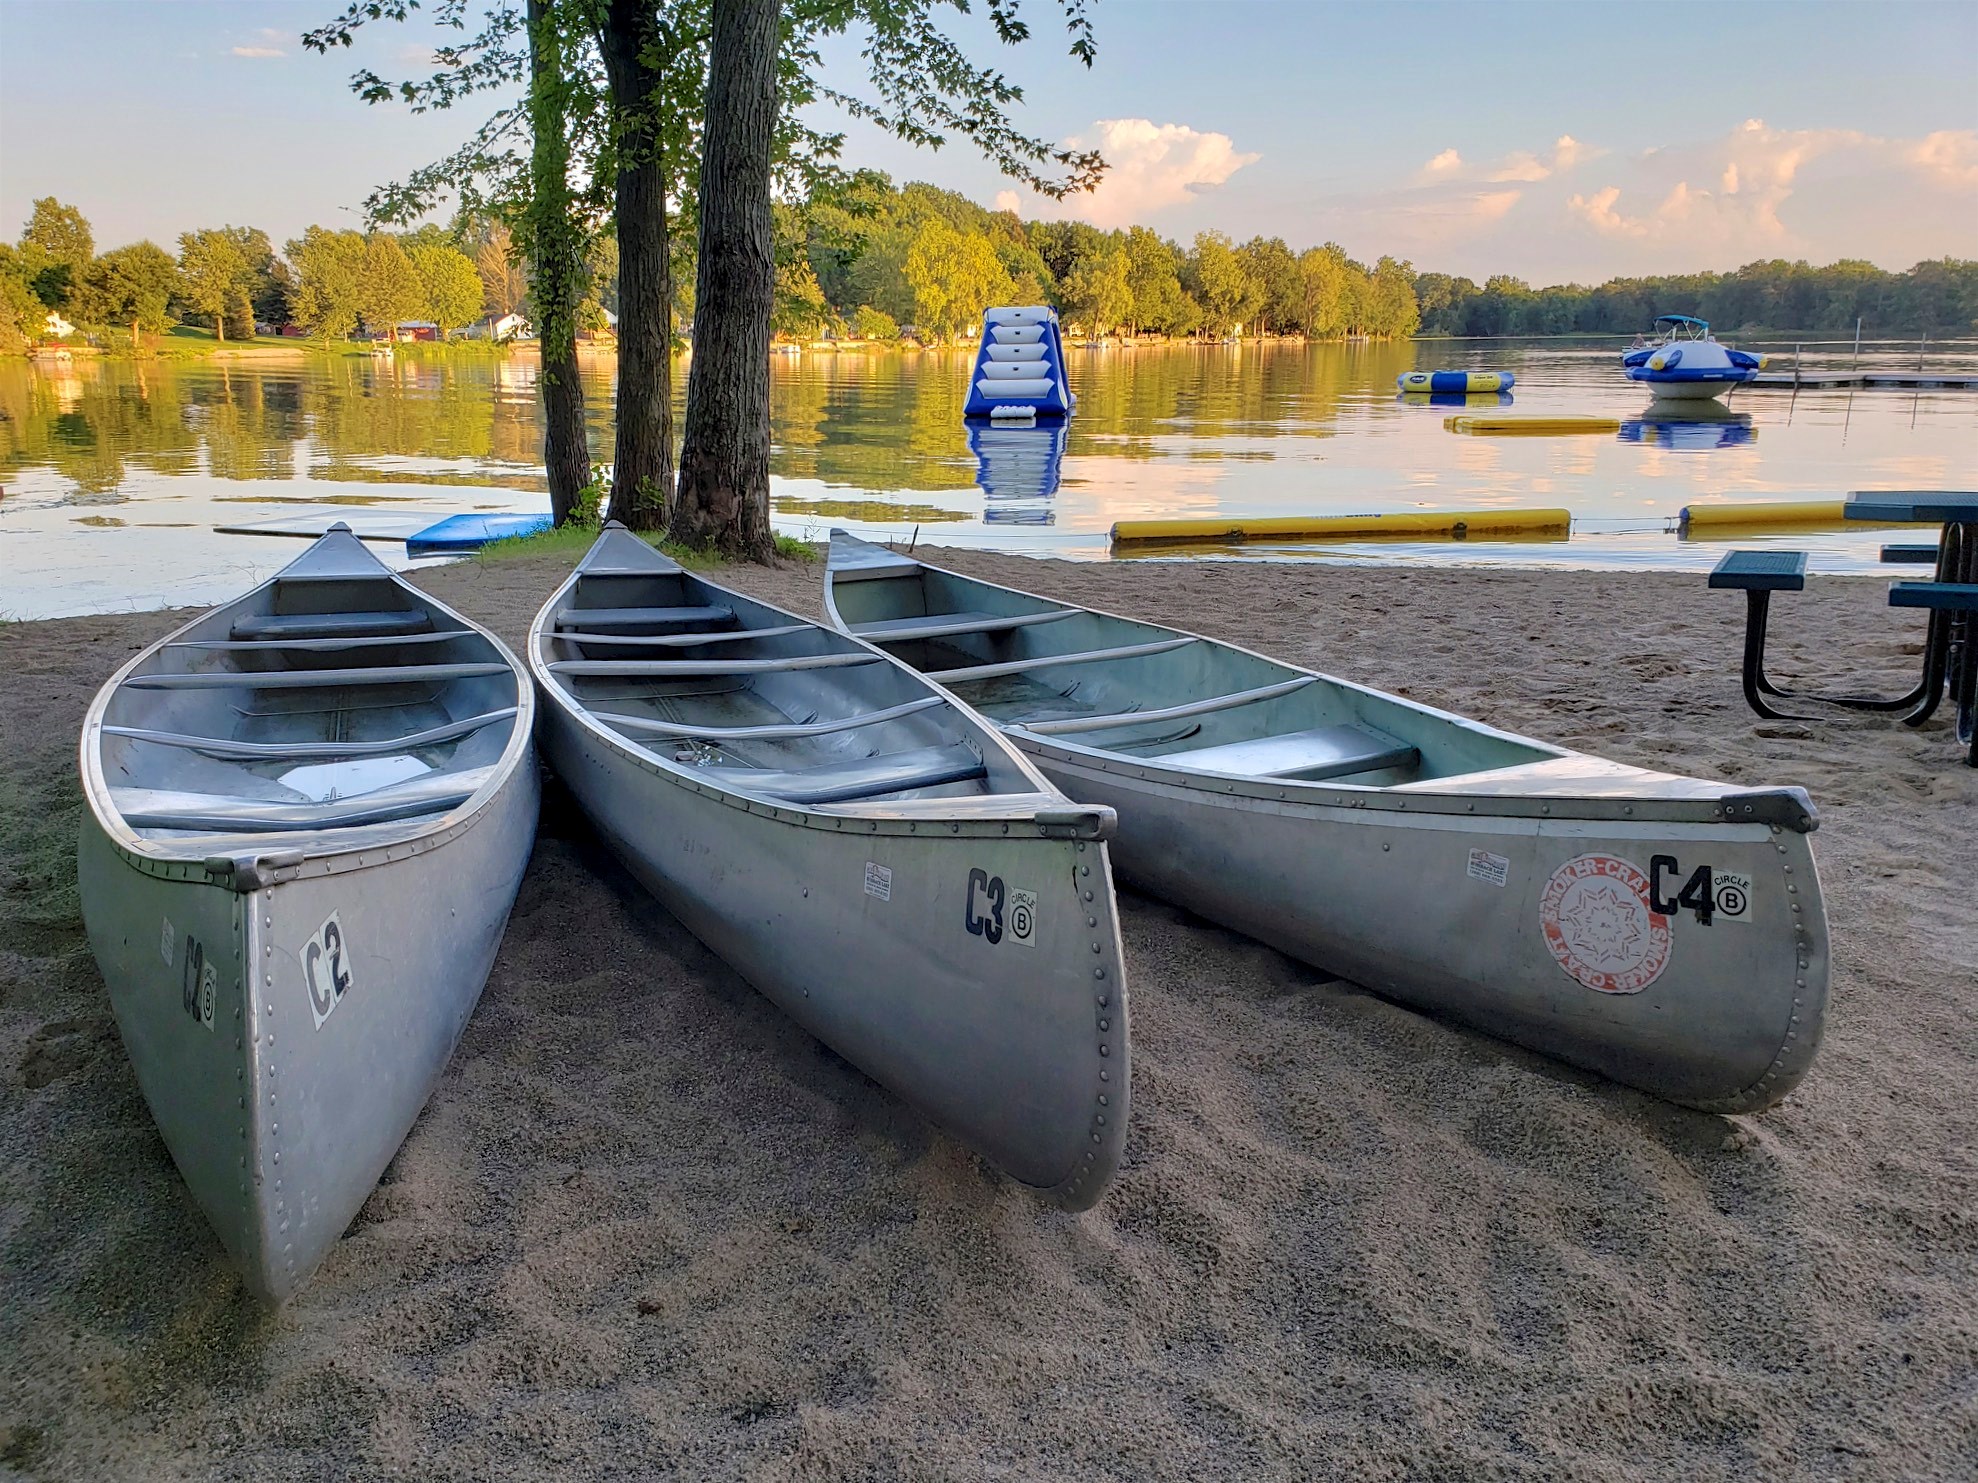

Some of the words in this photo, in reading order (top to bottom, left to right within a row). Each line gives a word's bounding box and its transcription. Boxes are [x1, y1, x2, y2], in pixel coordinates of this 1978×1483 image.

[1651, 855, 1715, 926] C4
[1714, 875, 1749, 890] CIRCLE
[966, 868, 1005, 945] C3
[1011, 893, 1036, 910] CIRCLE
[1725, 893, 1738, 909] B
[1017, 913, 1027, 931] B
[306, 921, 350, 1017] C2
